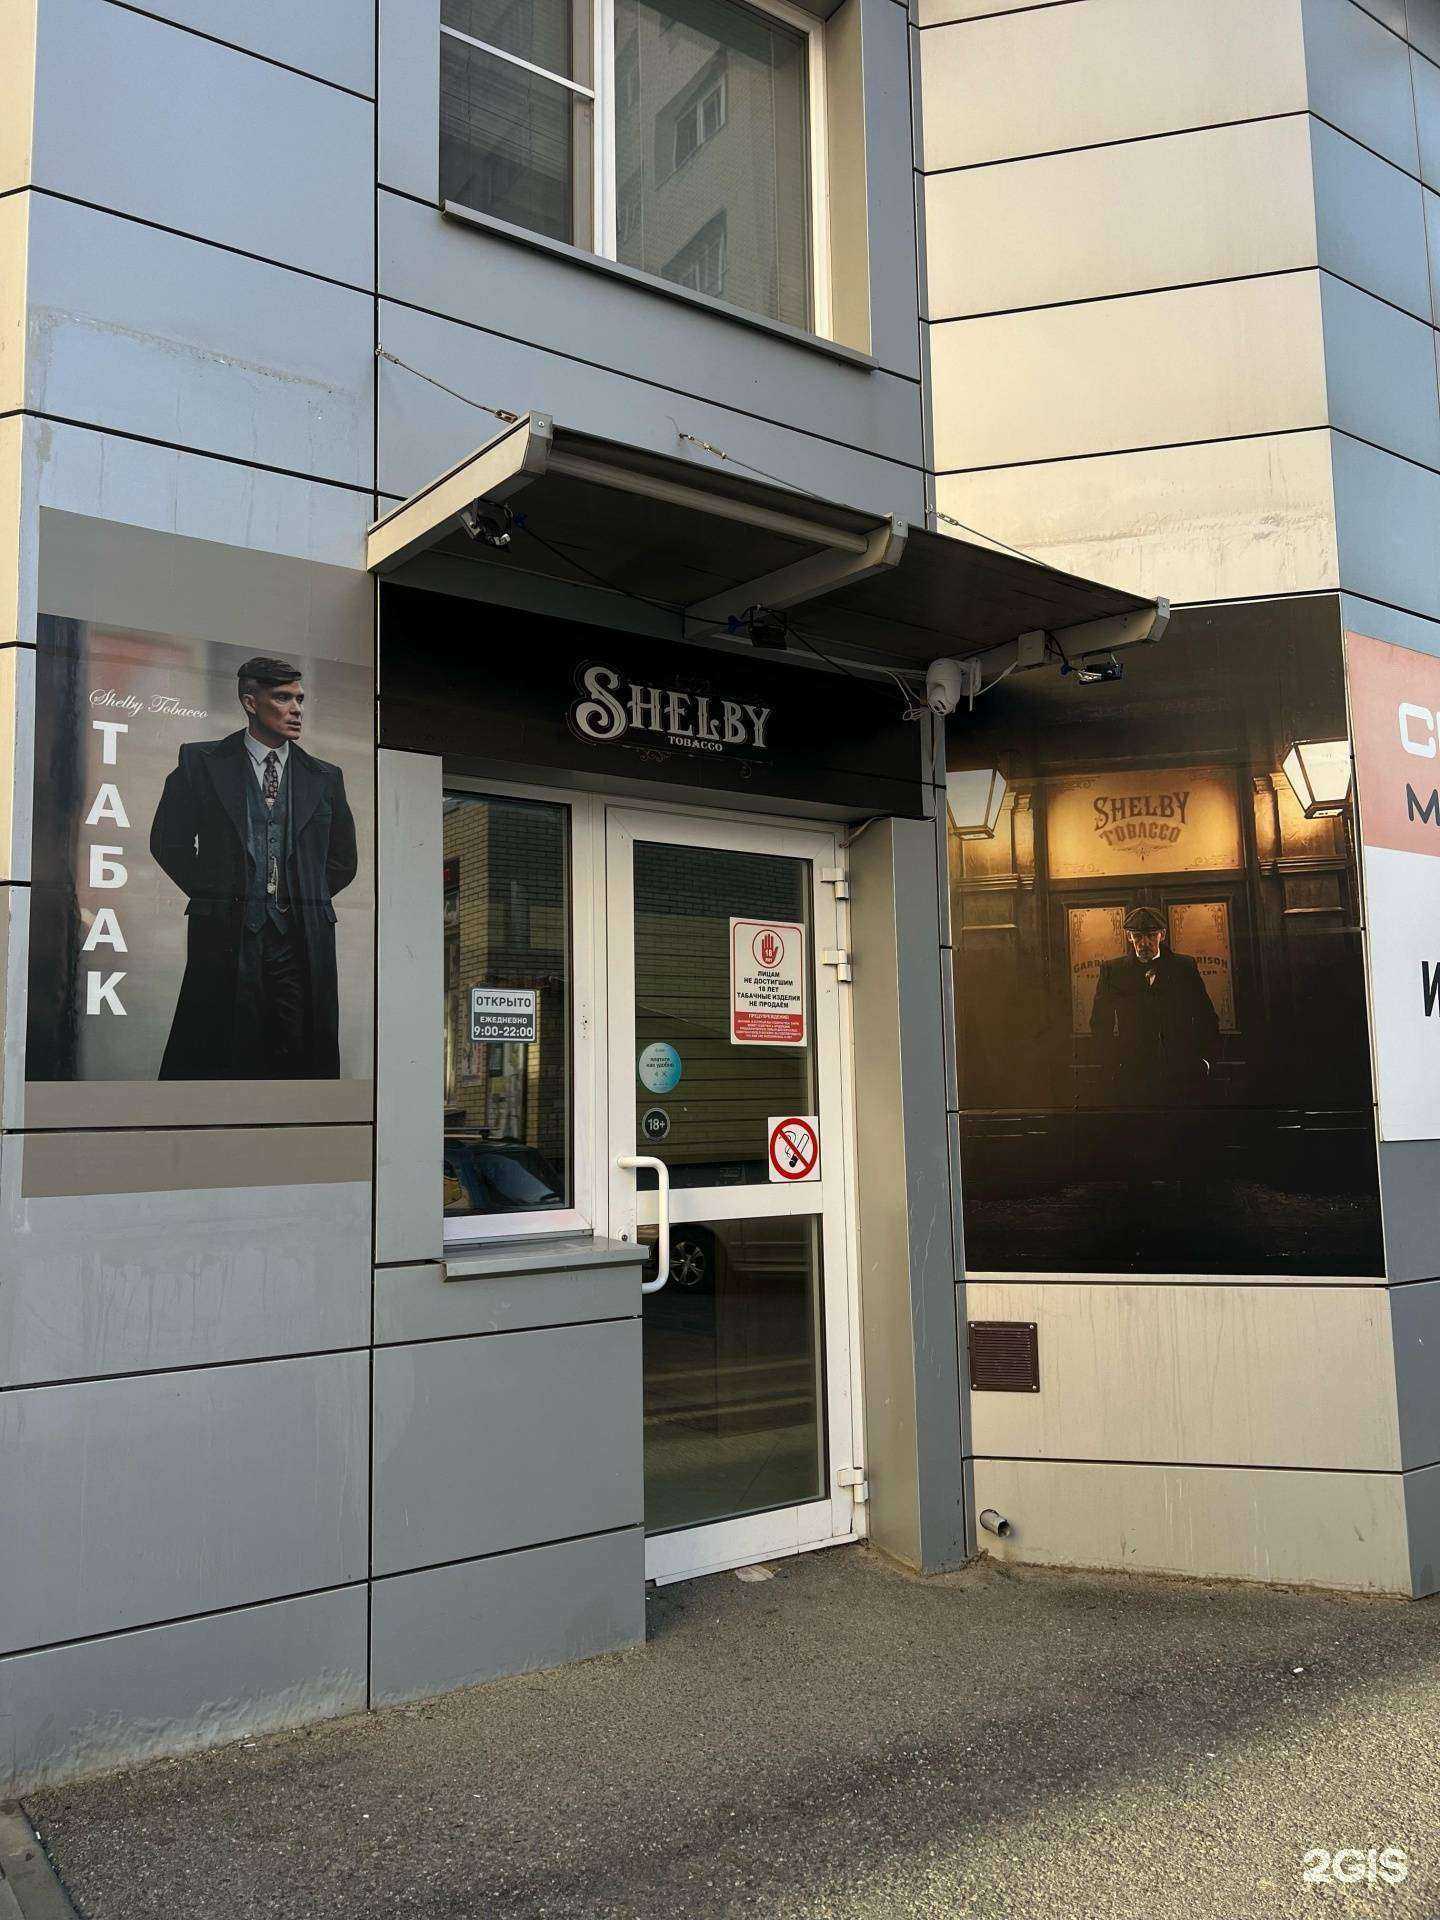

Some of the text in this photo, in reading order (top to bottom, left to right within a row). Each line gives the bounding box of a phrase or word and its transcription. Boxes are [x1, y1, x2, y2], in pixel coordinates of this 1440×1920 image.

[89, 689, 208, 718] Shelby Tobacco
[575, 666, 771, 748] SHELBY
[667, 735, 723, 752] TOBACCO
[1093, 791, 1190, 831] SHELBY
[1099, 822, 1182, 846] TOBACCO
[82, 720, 130, 1016] ТАБАК
[757, 970, 780, 978] ЛИЦАМ
[753, 978, 793, 986] ДОСТИГШИМ
[476, 996, 531, 1008] ОТКРЫТО
[737, 992, 801, 1002] ТАБАЧНЫЕ ИЗДЕЛИЯ
[480, 1016, 528, 1024] ЕЖЕДНЕВНО
[474, 1026, 533, 1037] 9:00-22:00
[647, 1118, 666, 1131] 18+
